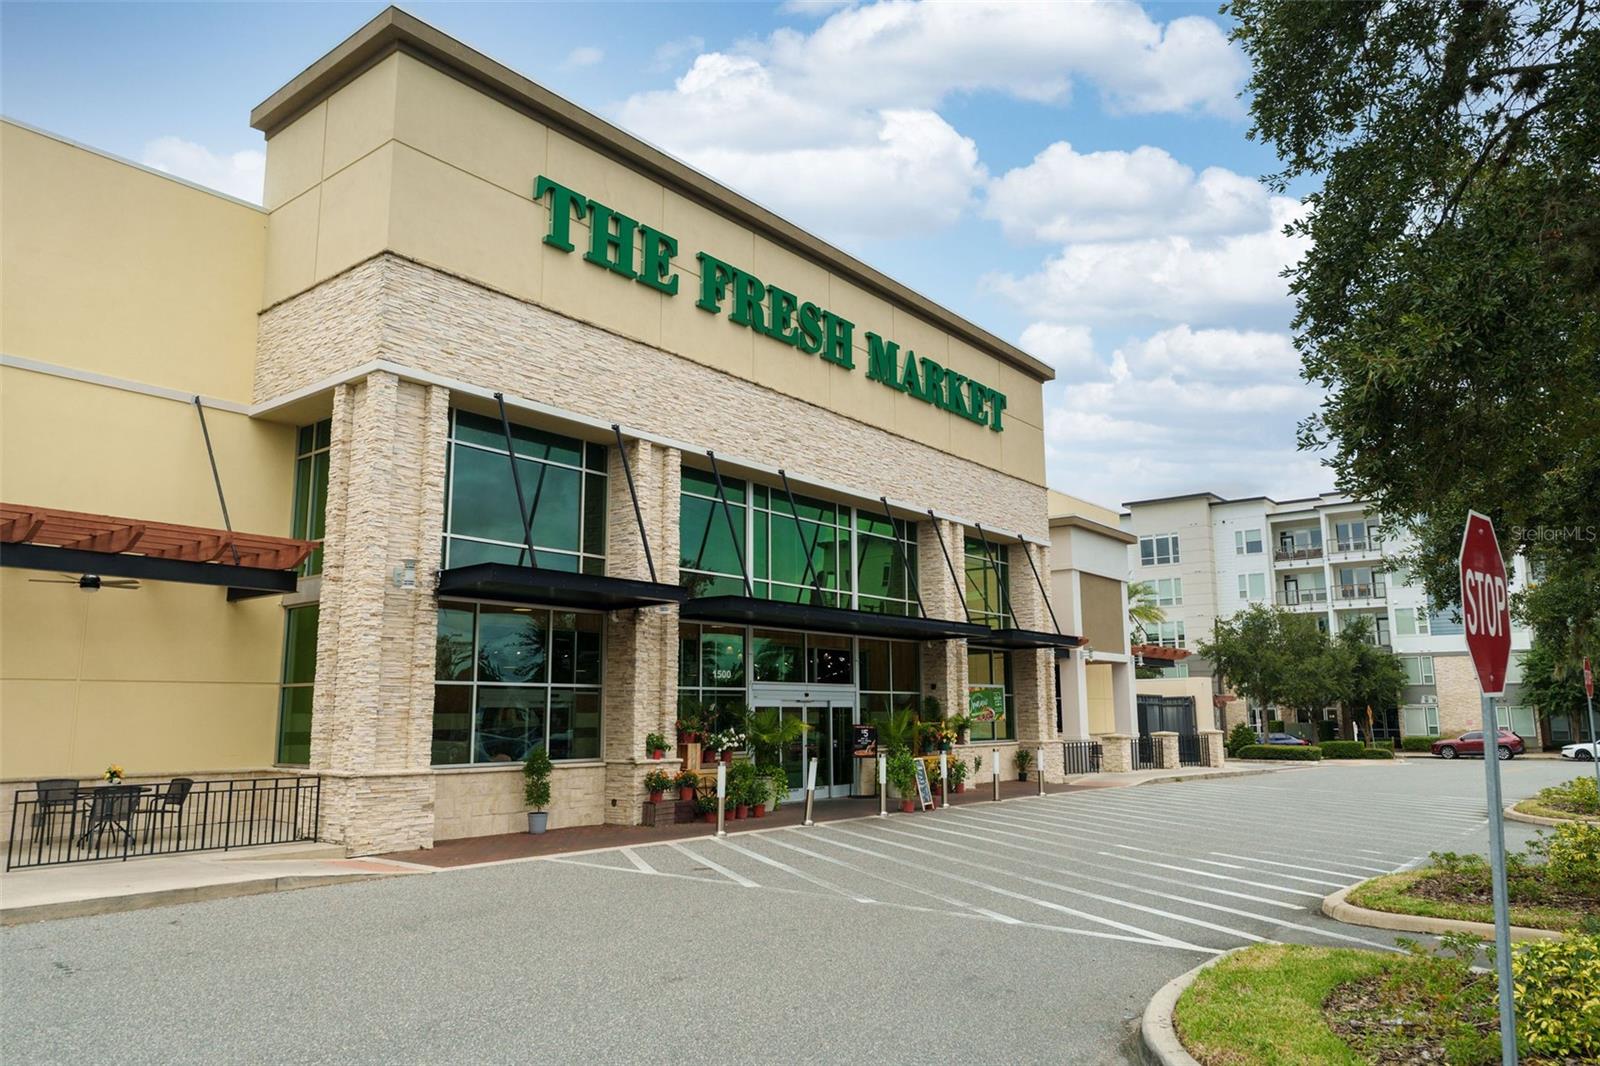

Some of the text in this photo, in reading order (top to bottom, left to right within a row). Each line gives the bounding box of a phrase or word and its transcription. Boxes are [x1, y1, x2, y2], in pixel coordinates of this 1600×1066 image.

[533, 175, 1007, 432] THE FRESH MARKET
[1465, 568, 1506, 637] STOP
[712, 670, 732, 679] 1500
